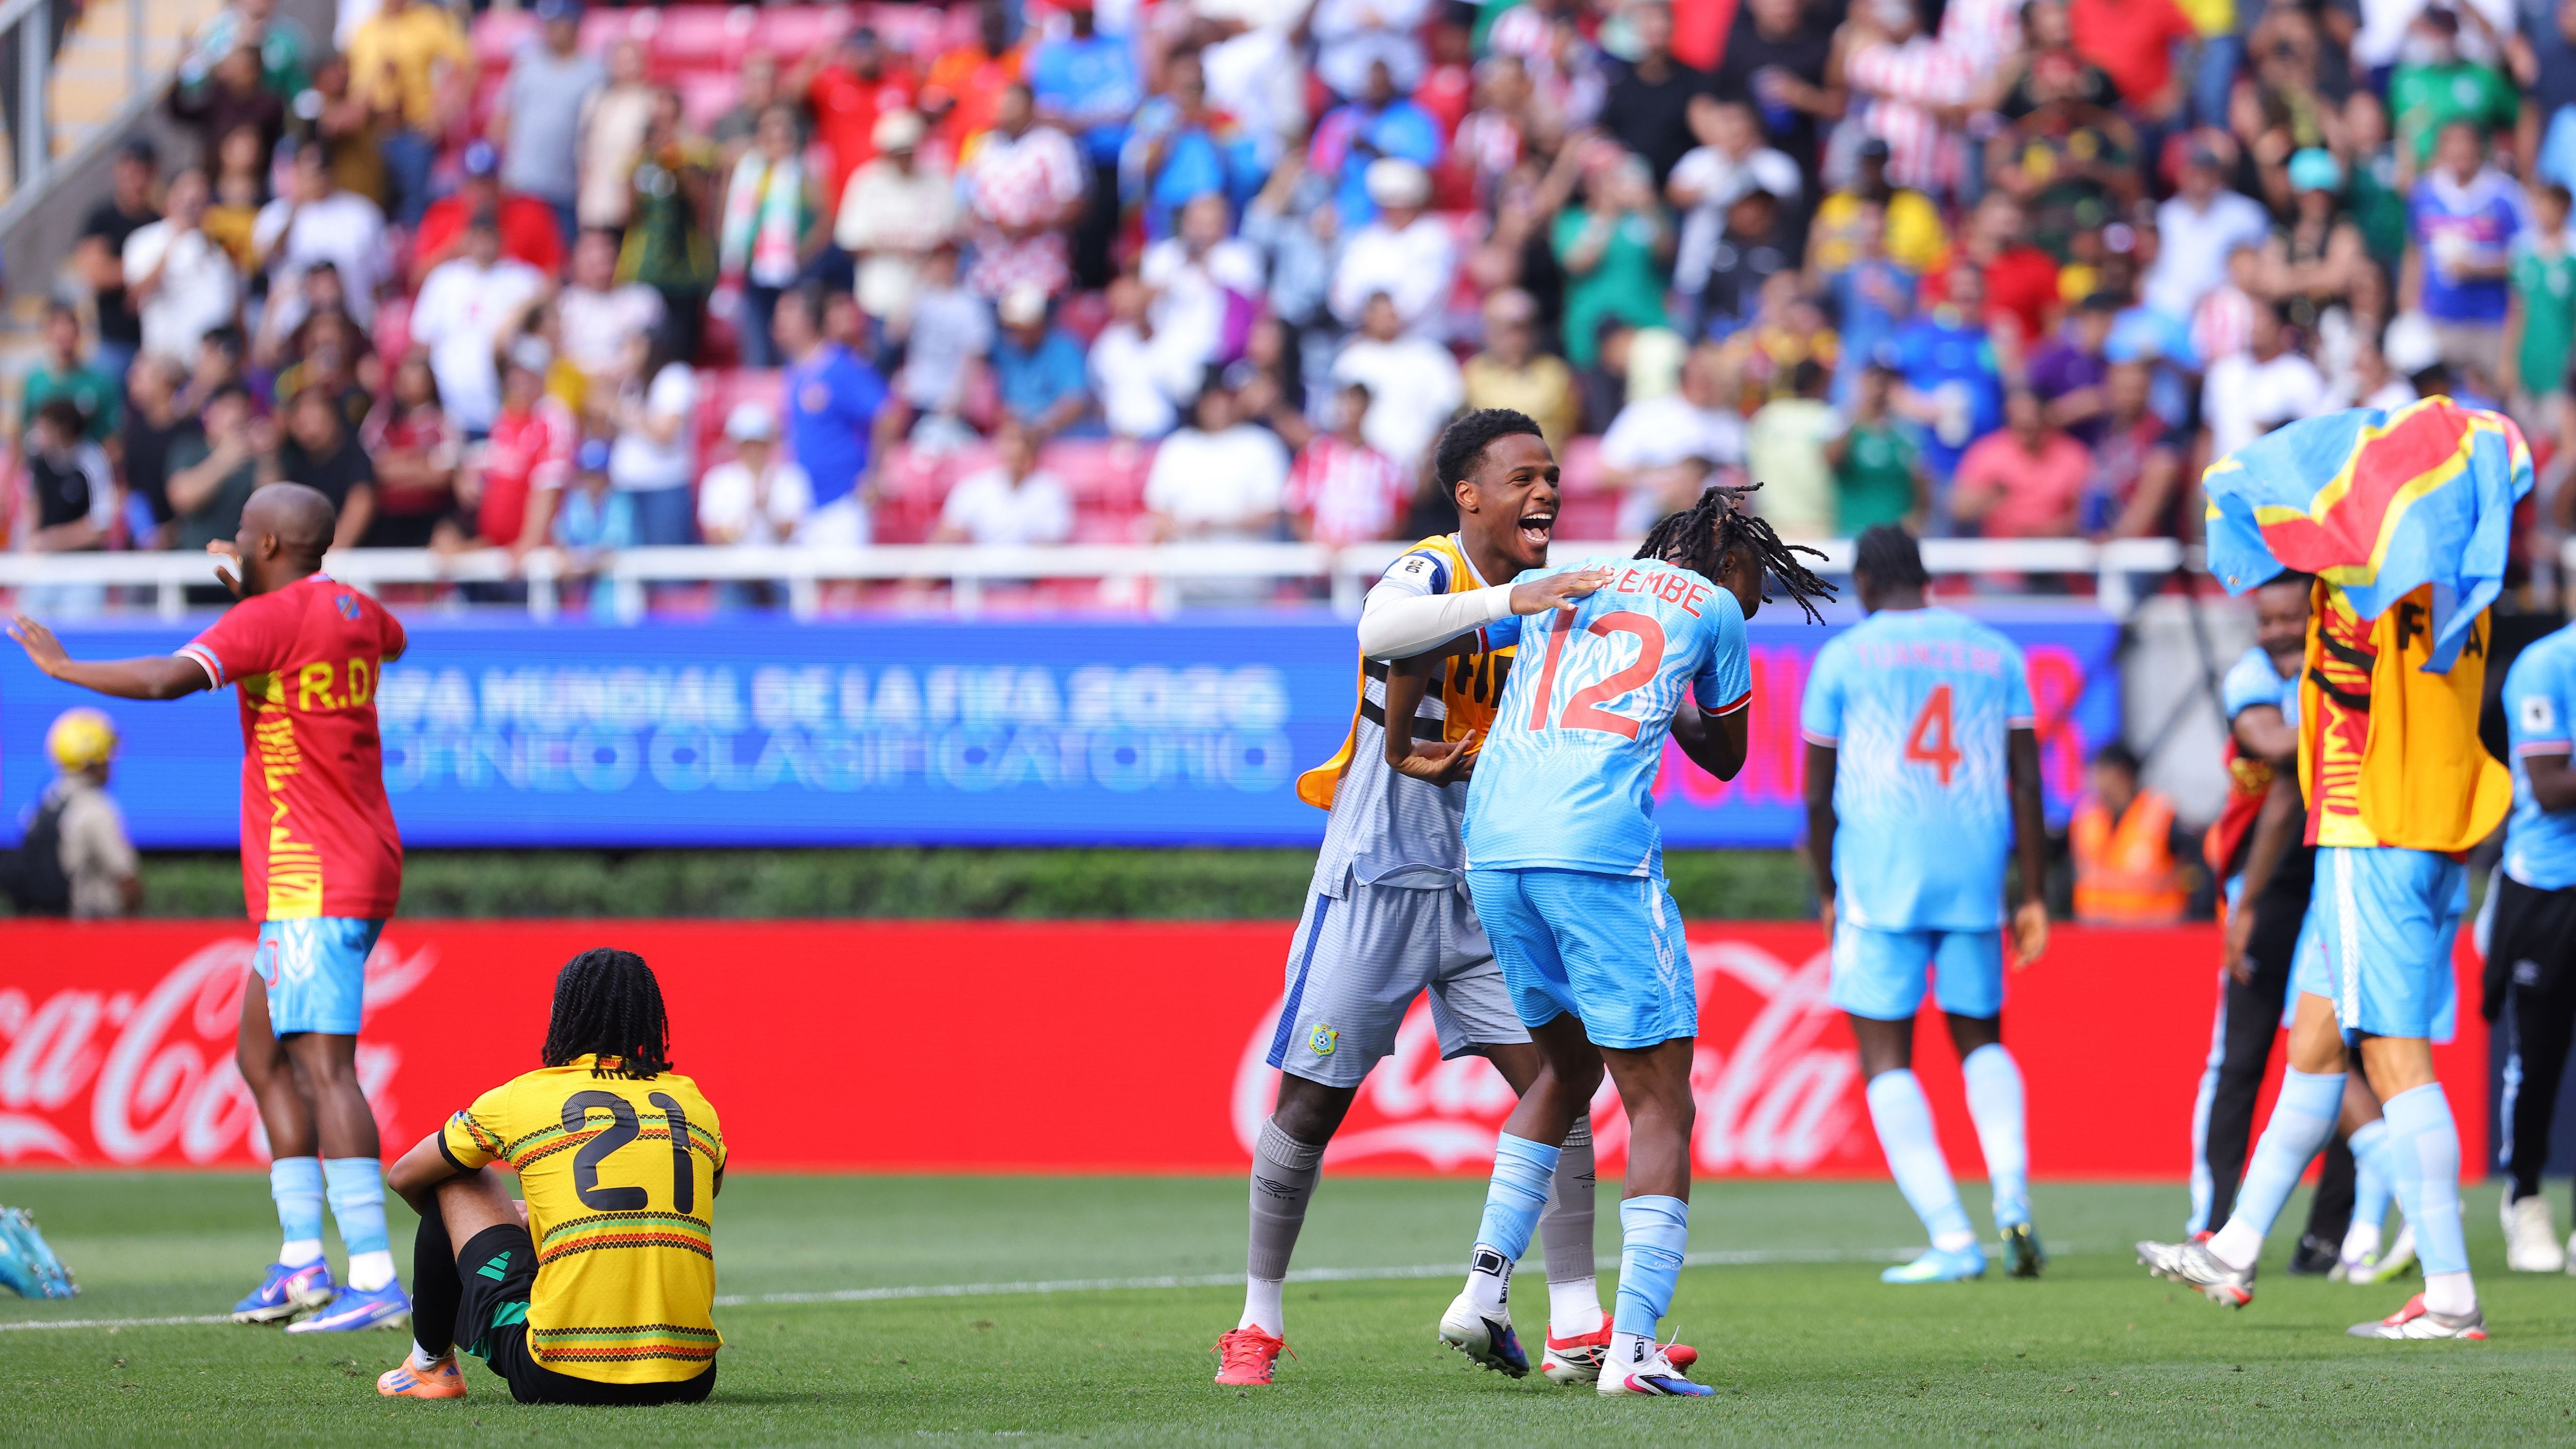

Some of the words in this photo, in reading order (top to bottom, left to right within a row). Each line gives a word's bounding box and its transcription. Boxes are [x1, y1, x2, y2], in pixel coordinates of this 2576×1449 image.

[1527, 607, 1666, 743] 12
[1903, 681, 1963, 788] 4
[560, 1090, 695, 1215] 21
